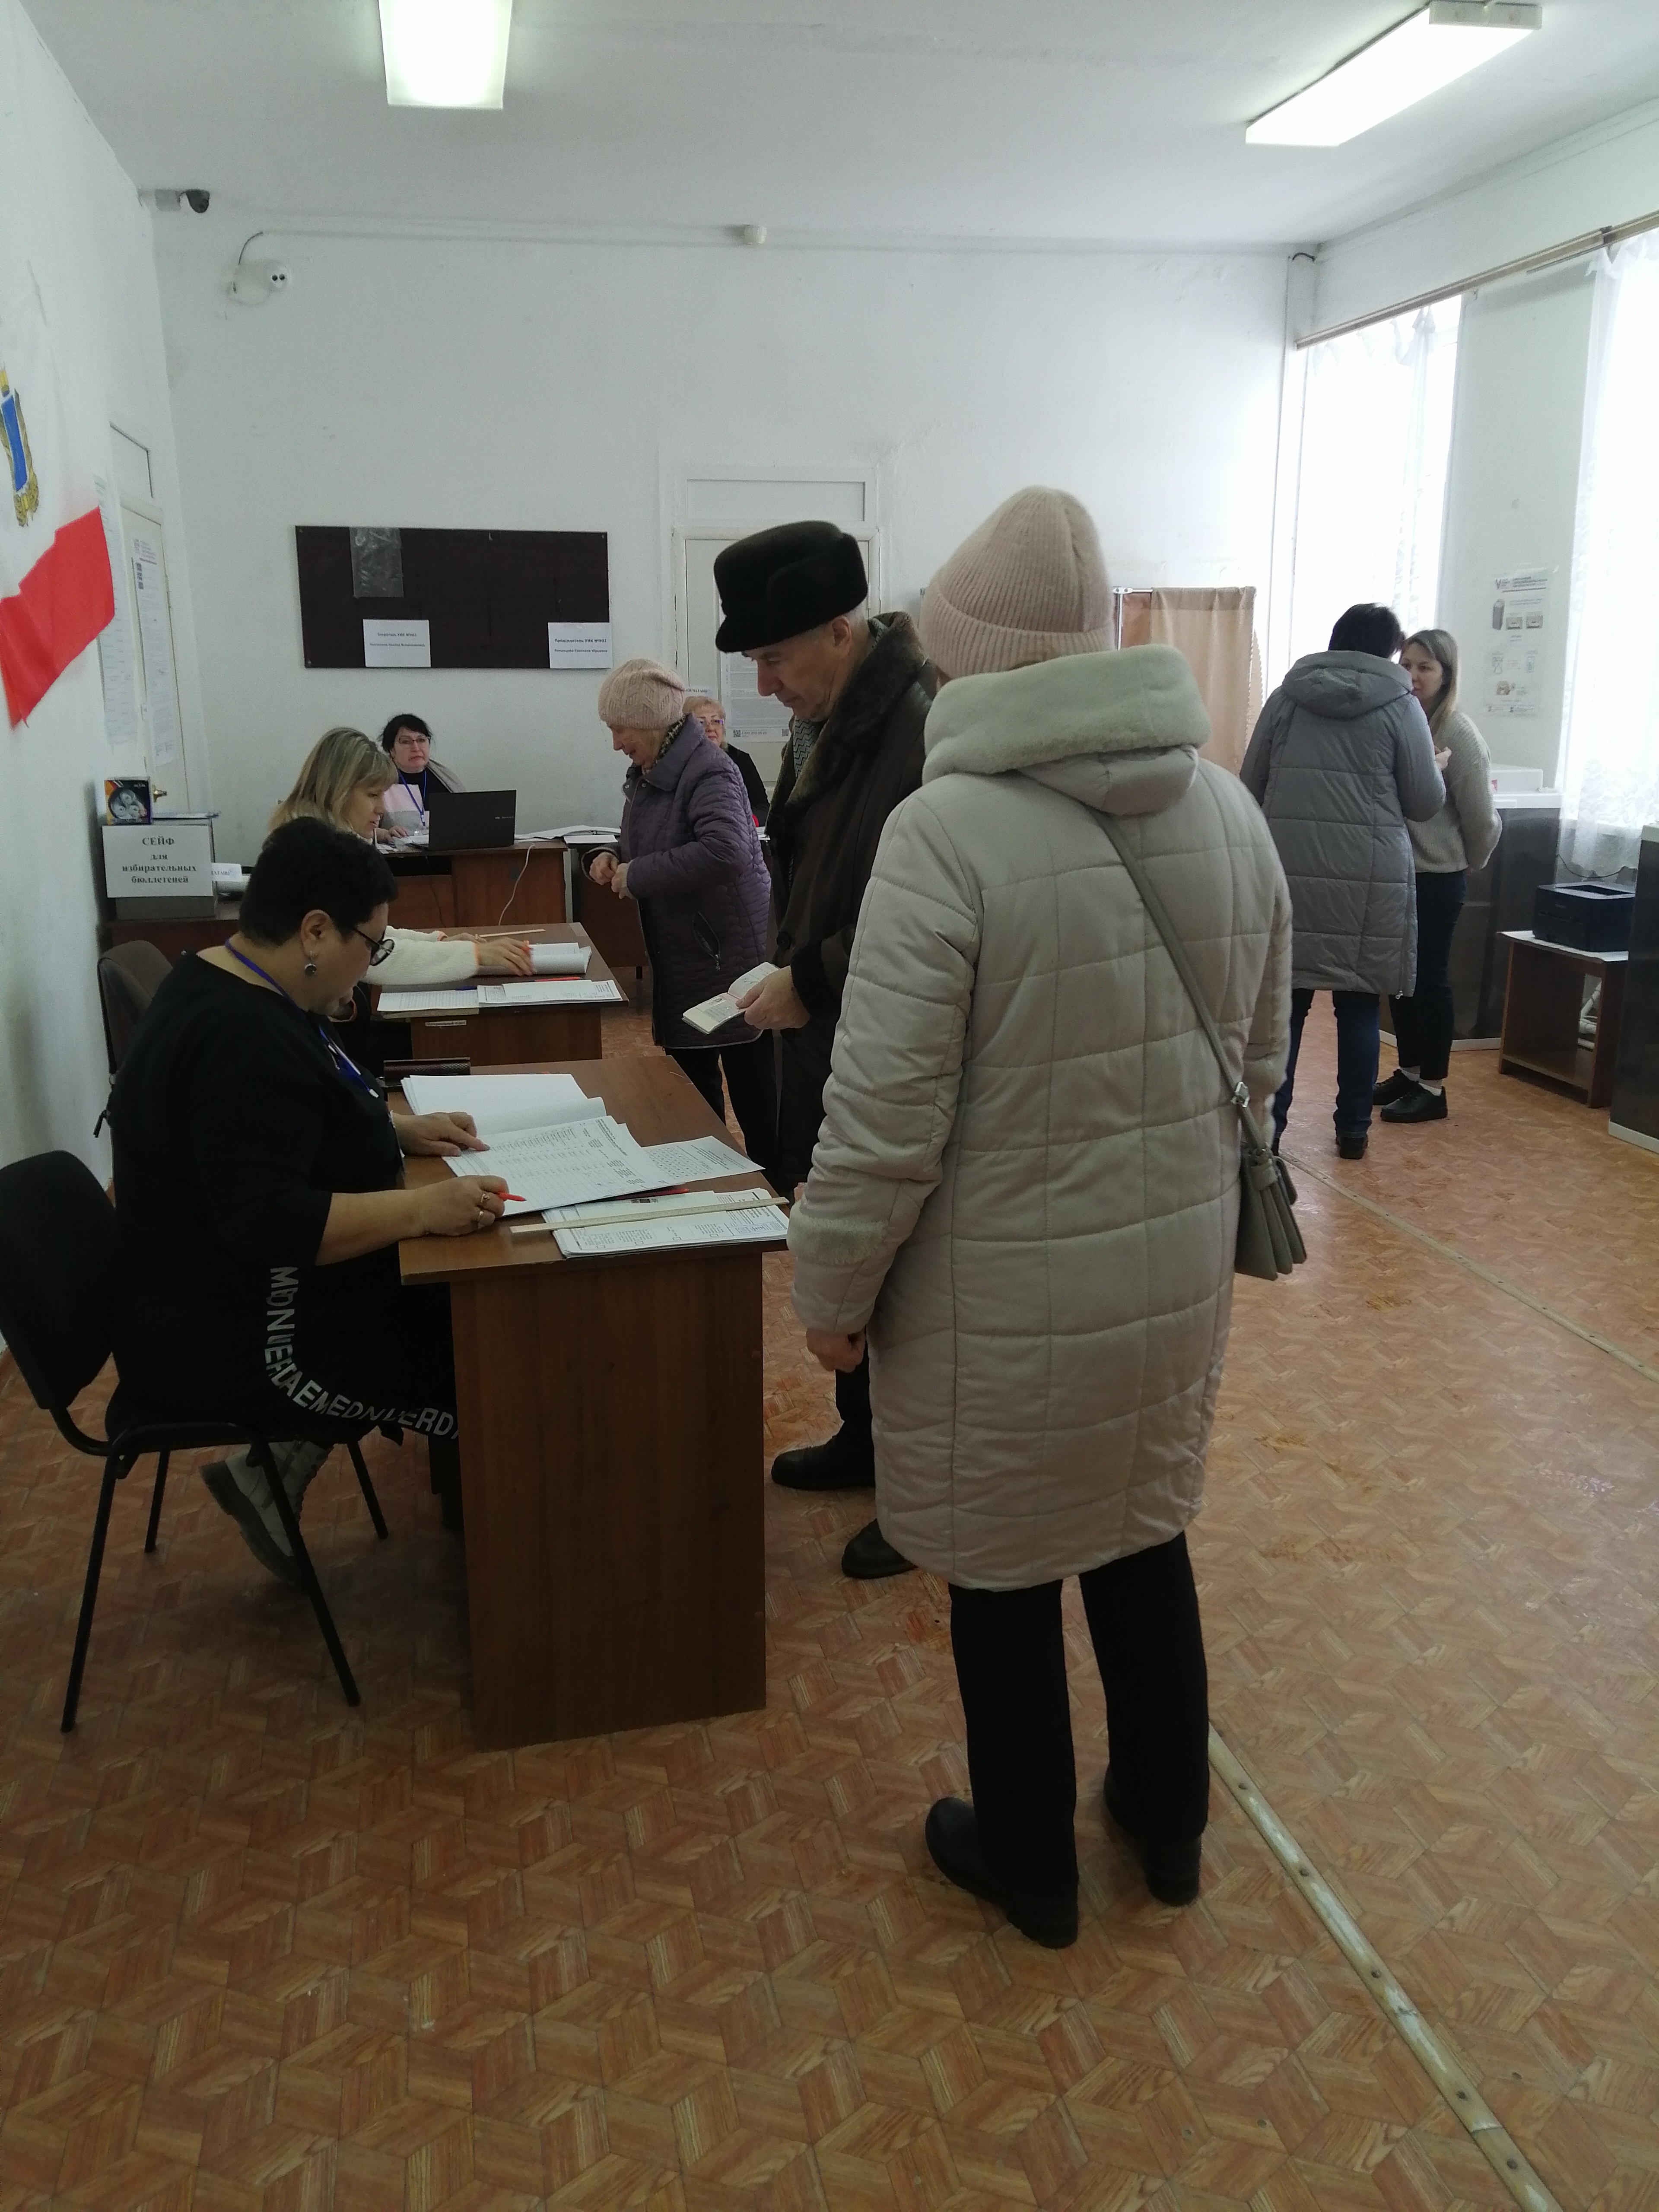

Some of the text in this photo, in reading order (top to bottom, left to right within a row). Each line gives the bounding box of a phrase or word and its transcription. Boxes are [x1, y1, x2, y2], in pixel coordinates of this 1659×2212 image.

[142, 836, 175, 845] СЕЙФ
[122, 864, 197, 873] избирательных
[131, 875, 189, 883] бюллетеней
